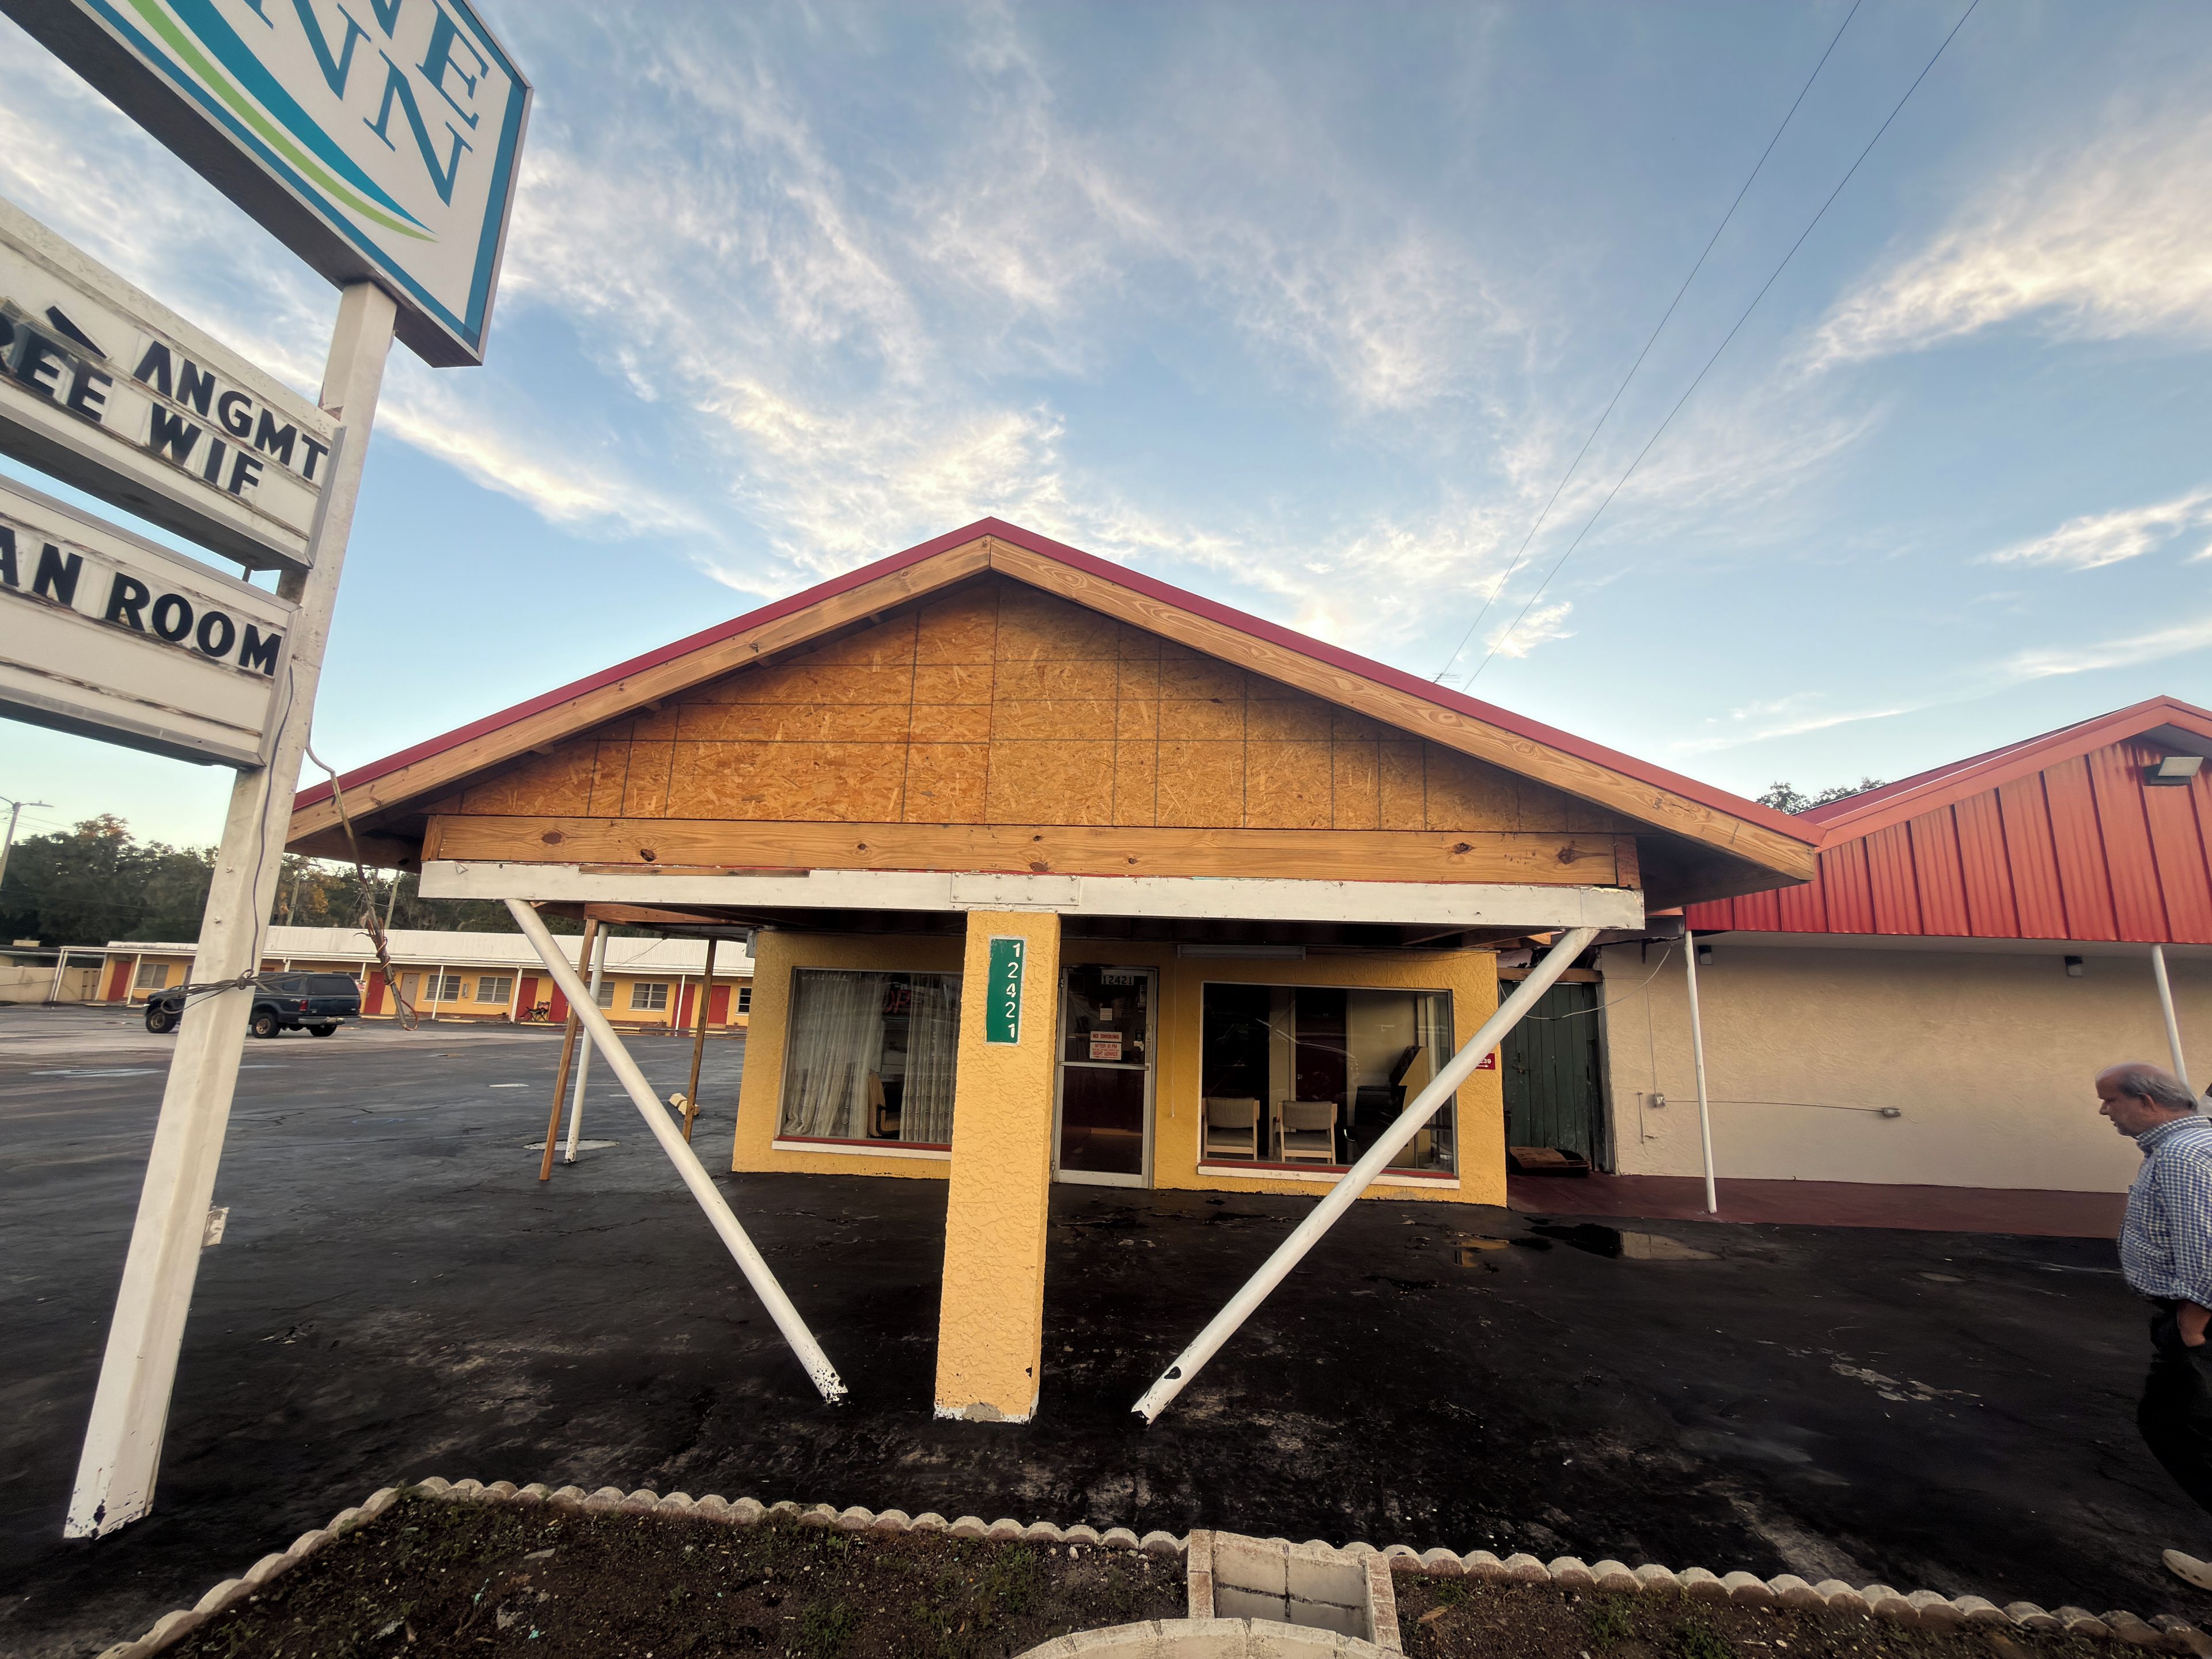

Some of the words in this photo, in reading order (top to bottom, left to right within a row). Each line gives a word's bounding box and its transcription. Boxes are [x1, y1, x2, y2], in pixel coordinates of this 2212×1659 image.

[150, 402, 264, 495] WIF
[105, 571, 282, 676] ROOM
[1005, 942, 1021, 1039] 12421
[1103, 975, 1132, 985] 12421
